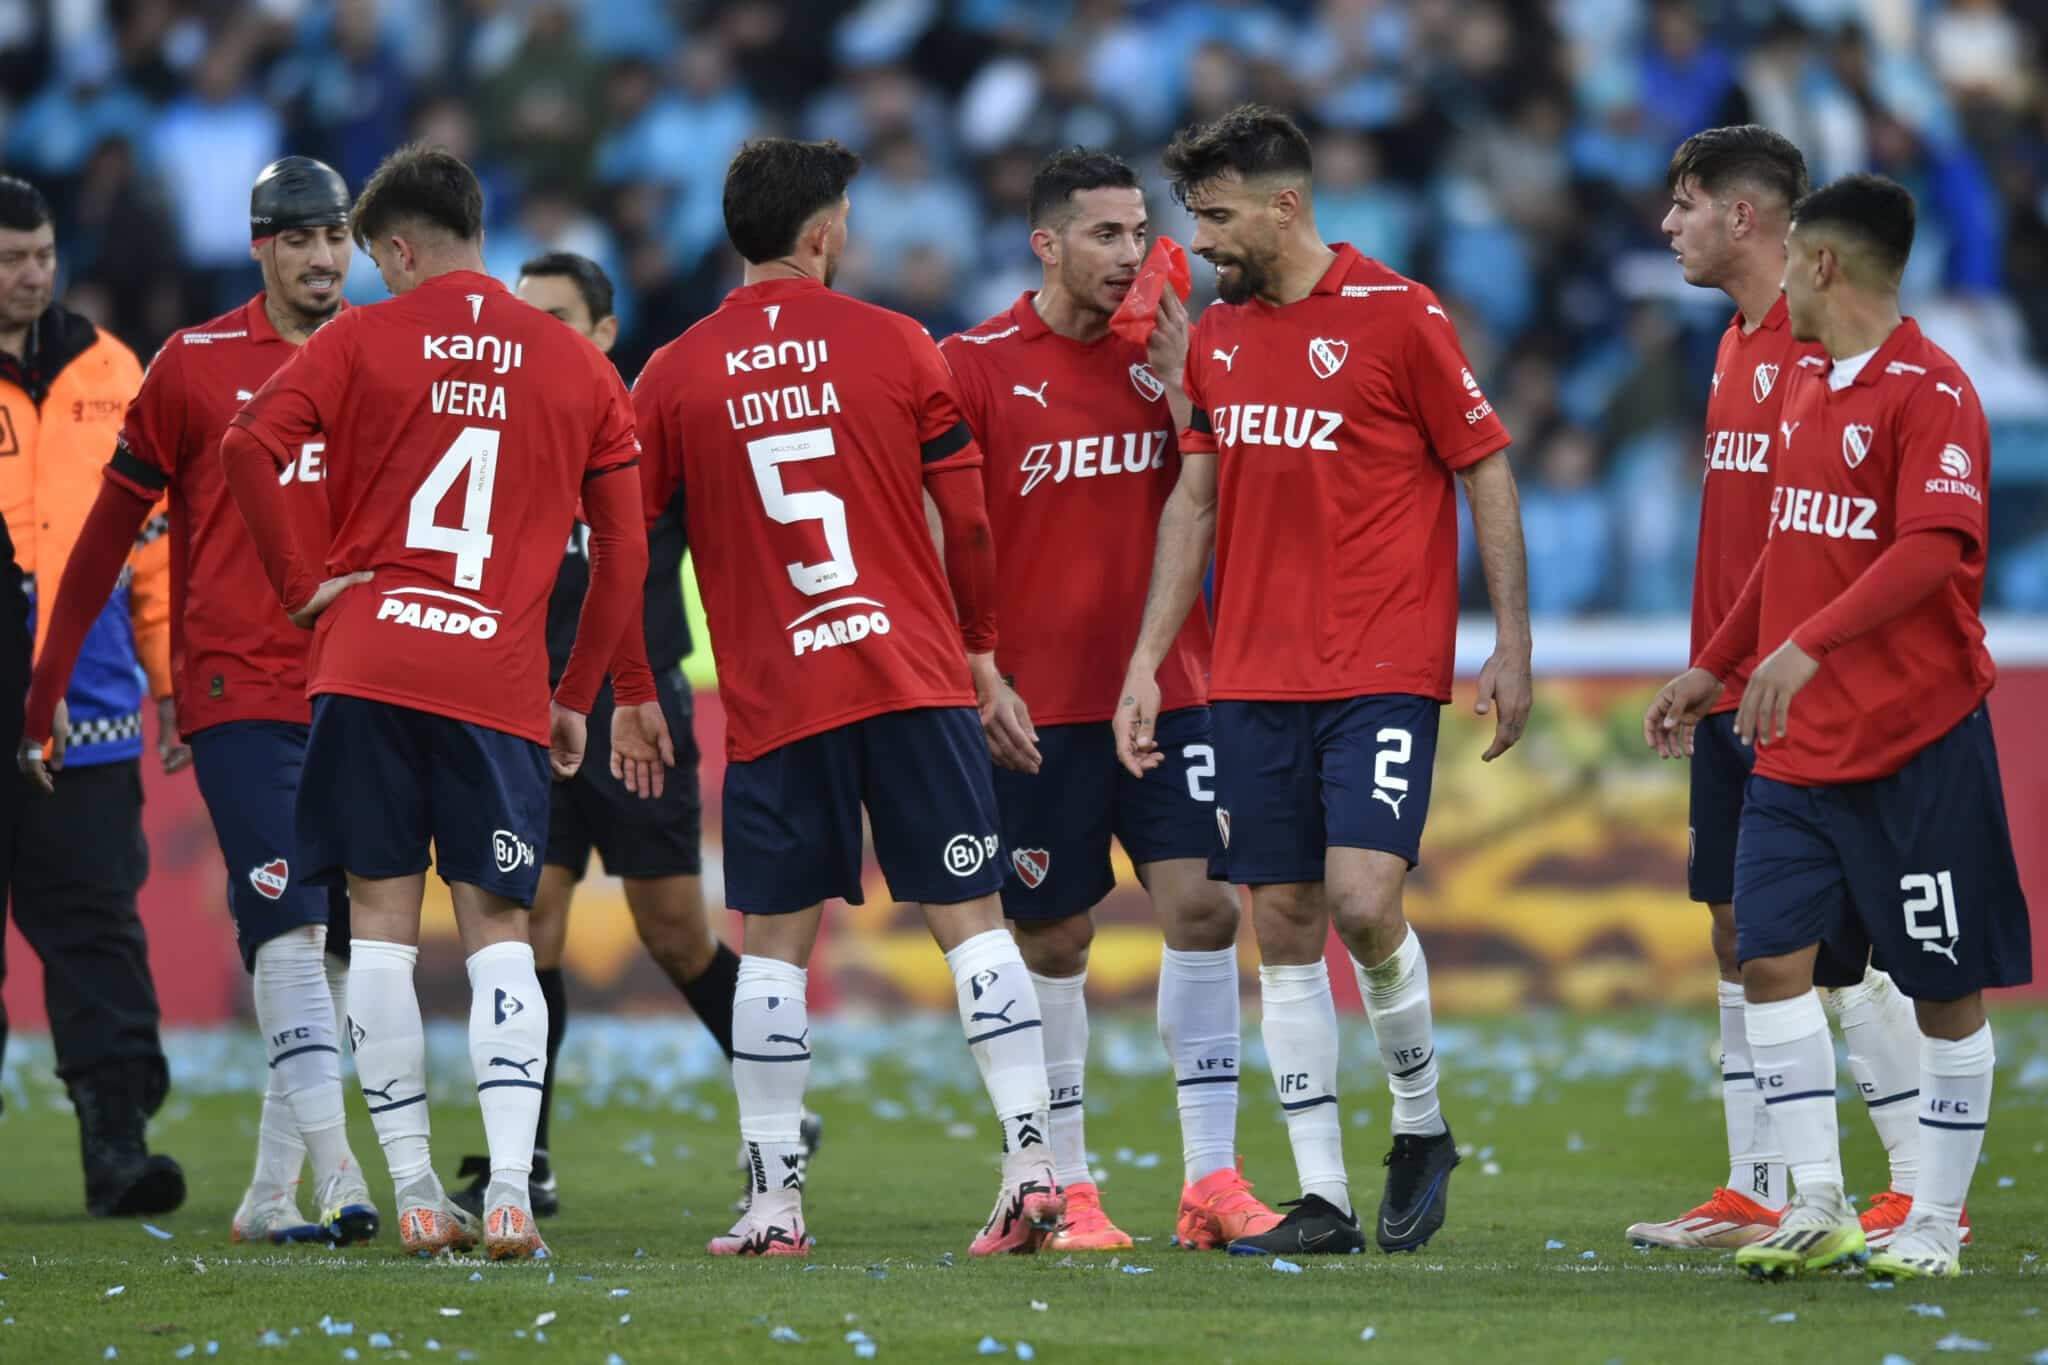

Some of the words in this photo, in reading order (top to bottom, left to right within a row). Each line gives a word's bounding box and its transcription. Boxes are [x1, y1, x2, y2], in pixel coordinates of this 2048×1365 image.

[431, 380, 507, 420] VERA
[726, 381, 841, 430] LOYOLA
[1225, 404, 1344, 451] JELUZ
[1053, 430, 1168, 483] JELUZ
[1710, 431, 1770, 473] ELUZ
[406, 426, 501, 590] 4
[746, 427, 859, 596] 5
[1779, 486, 1878, 540] JELUZ
[1925, 478, 1982, 505] SCIENZA
[377, 597, 499, 640] PARDO
[793, 611, 890, 657] PARDO
[1183, 744, 1216, 802] 2
[1374, 727, 1412, 792] 2
[1900, 870, 1960, 939] 21
[272, 1027, 310, 1048] IFC
[1393, 1046, 1424, 1065] IFC
[1197, 1058, 1235, 1070] IFC
[1281, 1073, 1308, 1093] IFC
[1050, 1085, 1080, 1101] IFC
[1931, 1098, 1969, 1114] IFC
